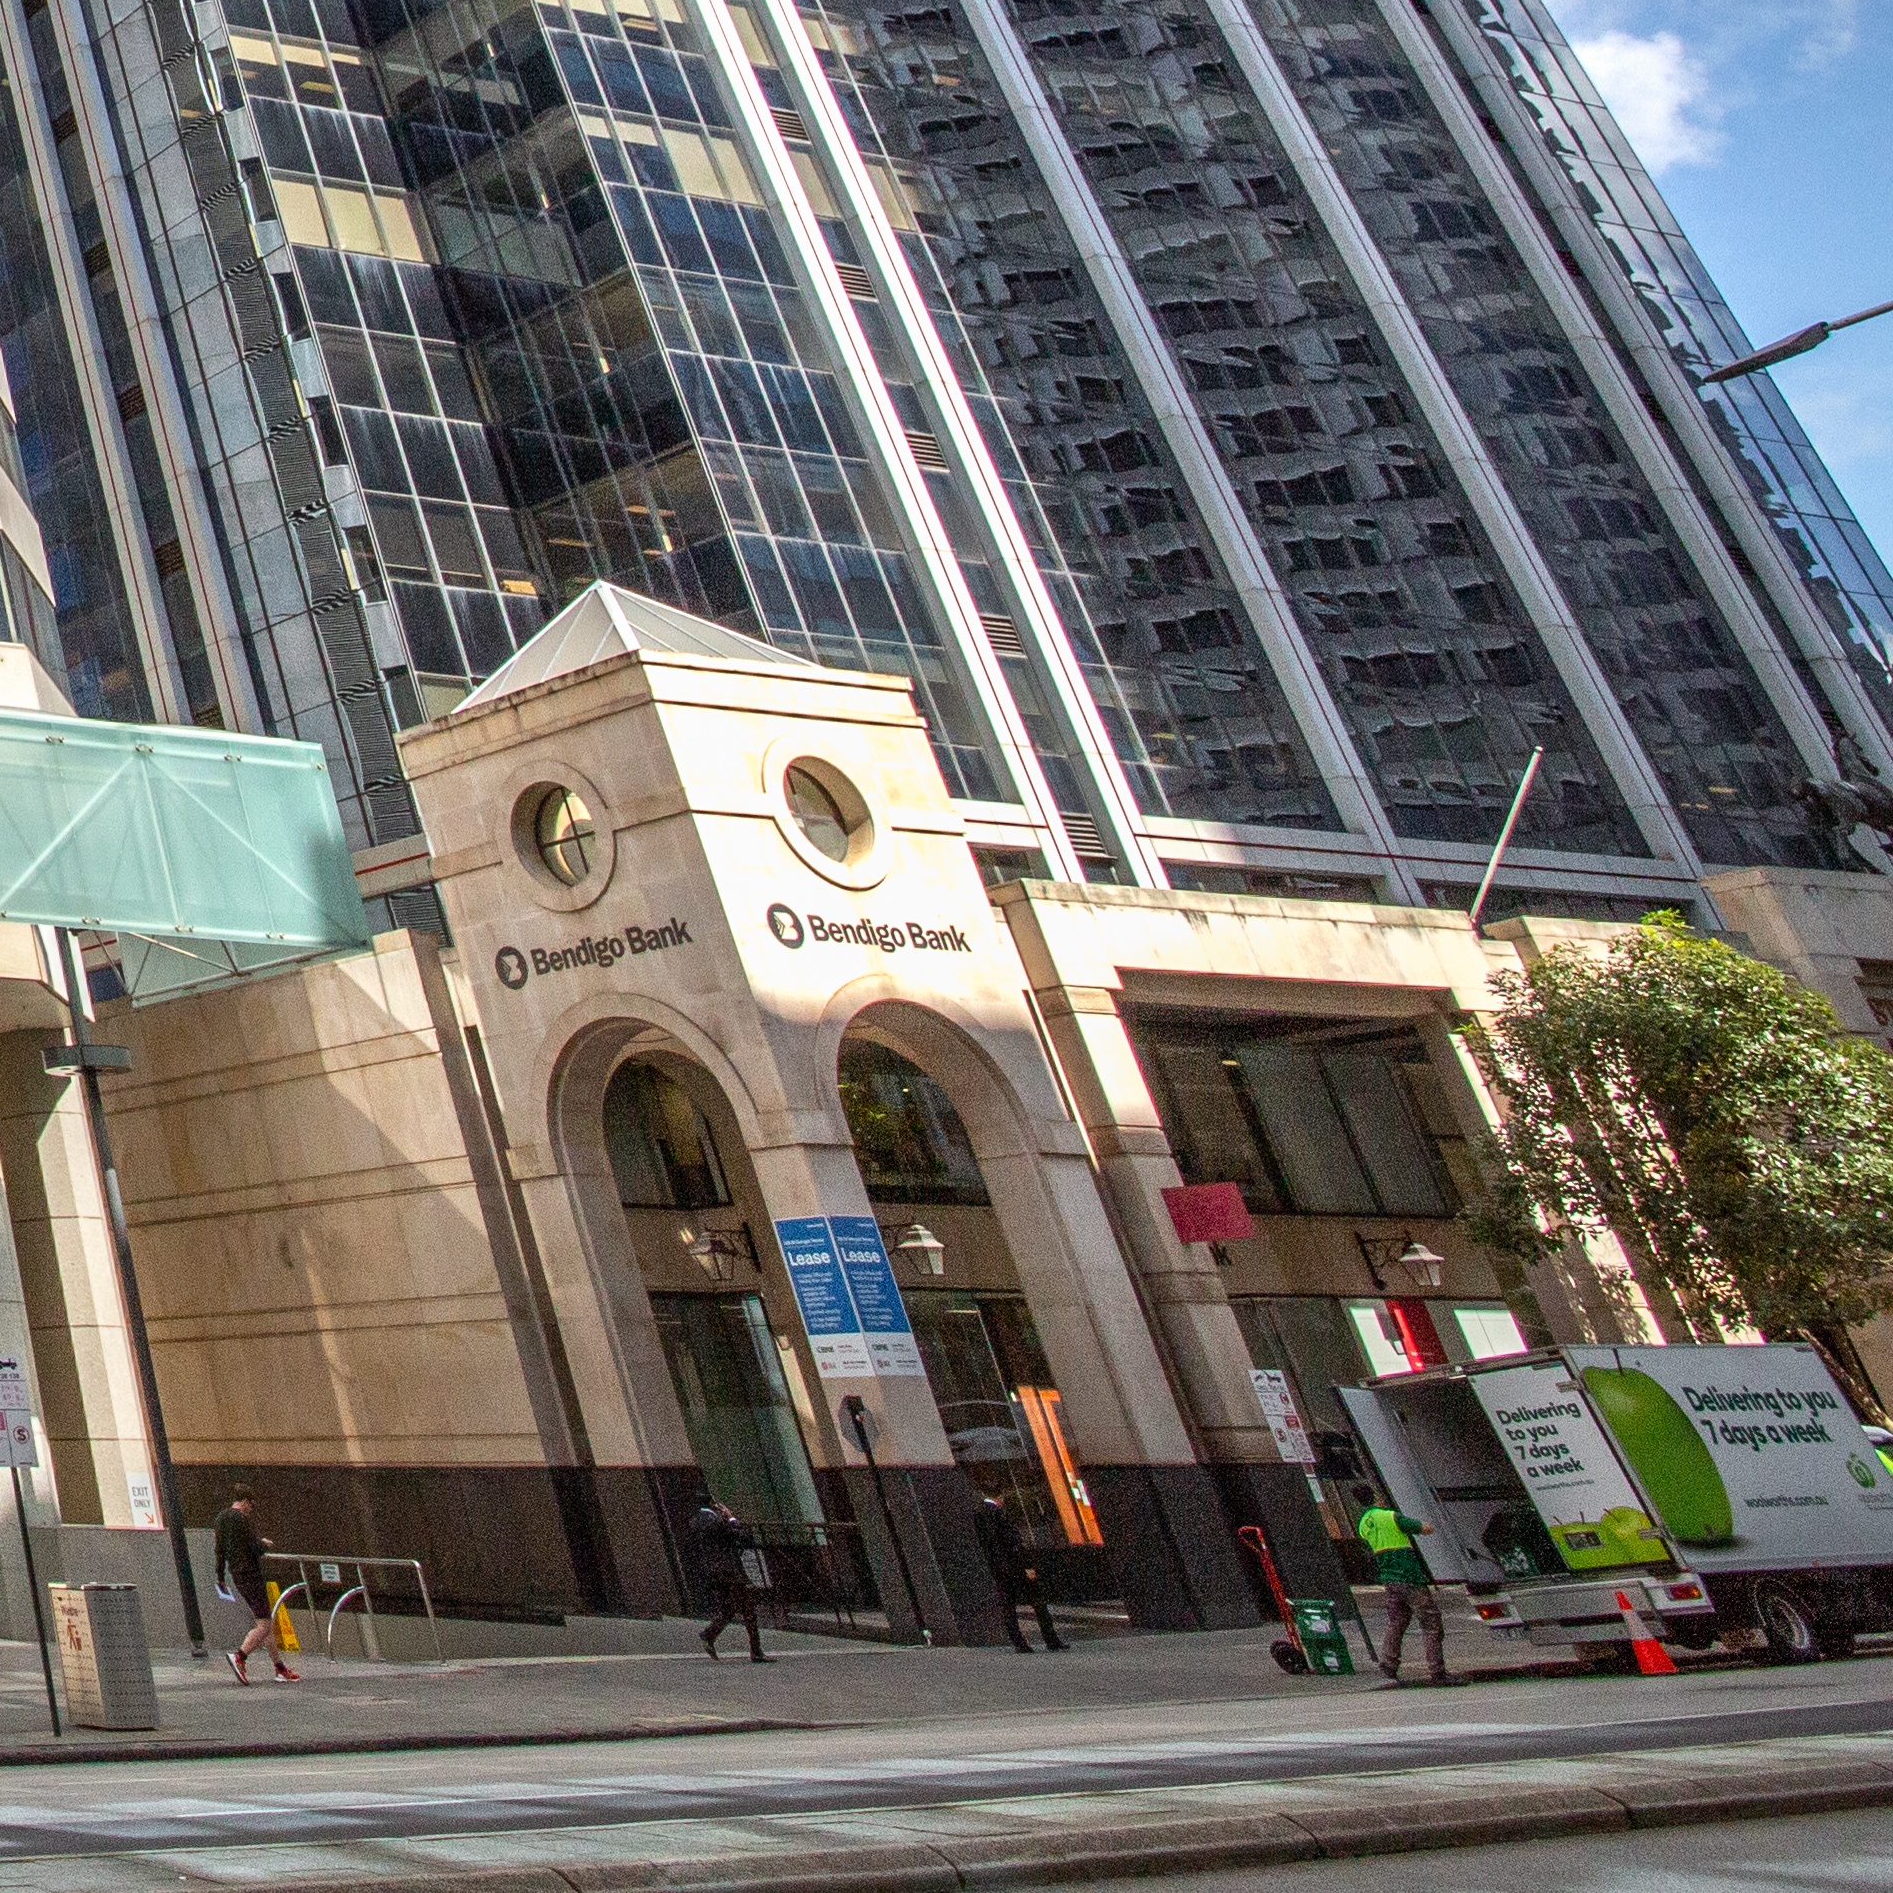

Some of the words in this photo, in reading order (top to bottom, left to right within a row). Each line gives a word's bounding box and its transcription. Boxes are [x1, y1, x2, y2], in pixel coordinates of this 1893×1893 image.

[806, 914, 906, 953] Bendigo
[905, 921, 973, 953] Bank
[530, 936, 625, 977] Bendigo
[625, 917, 694, 955] Bank
[787, 1251, 831, 1267] Lease
[840, 1247, 881, 1263] Lease
[1681, 1386, 1784, 1418] Delivering
[1776, 1387, 1802, 1410] to
[1800, 1391, 1839, 1417] you
[1496, 1402, 1581, 1425] Delivering
[1505, 1428, 1526, 1441] to
[1526, 1424, 1559, 1442] you
[1701, 1419, 1718, 1445] 7
[1719, 1419, 1767, 1452] days
[1766, 1424, 1783, 1443] a
[1778, 1418, 1833, 1443] week
[1514, 1445, 1526, 1460] 7
[1529, 1444, 1570, 1460] days
[1526, 1466, 1540, 1478] a
[1539, 1457, 1585, 1476] week
[132, 1486, 149, 1497] EXIT
[133, 1499, 151, 1509] ONLY
